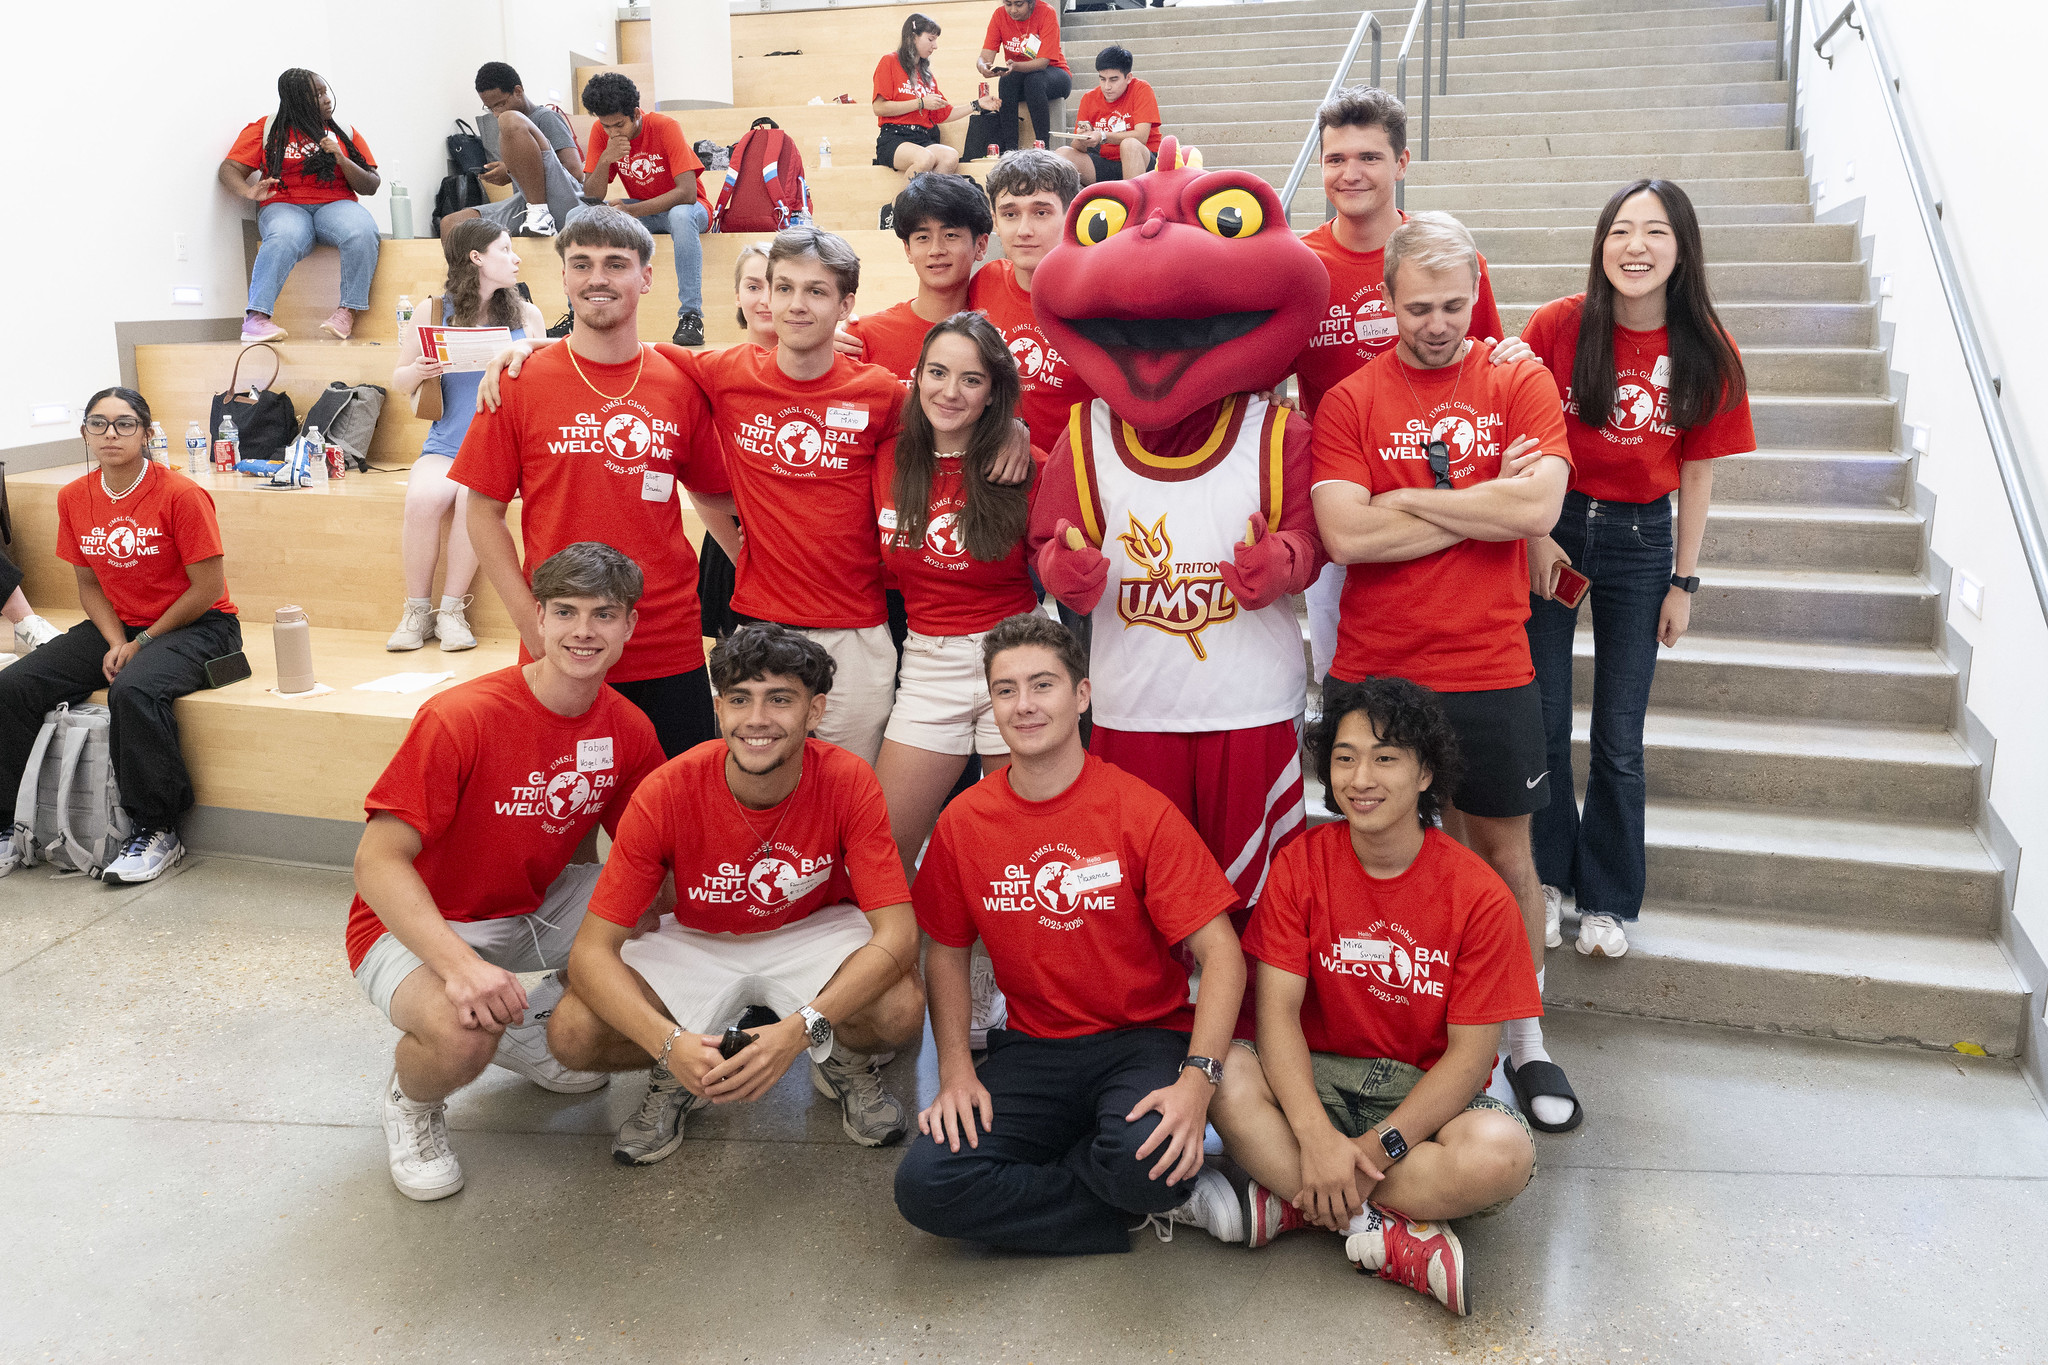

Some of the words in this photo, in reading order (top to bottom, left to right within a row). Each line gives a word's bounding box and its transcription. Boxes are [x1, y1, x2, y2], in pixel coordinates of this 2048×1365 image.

[648, 153, 663, 161] BAL
[652, 166, 665, 174] ME
[1351, 284, 1374, 303] UMSL
[1329, 304, 1351, 319] GL
[1012, 323, 1033, 334] UMSL
[1319, 318, 1352, 333] TRIT
[1309, 332, 1355, 348] WELC
[1042, 359, 1056, 373] N
[1039, 372, 1064, 388] ME
[601, 398, 626, 414] UMSL
[628, 399, 654, 418] Global
[1429, 403, 1451, 419] UMSL
[1453, 401, 1478, 416] Global
[1653, 406, 1667, 419] N
[575, 412, 601, 426] GL
[651, 417, 681, 437] BAL
[778, 406, 802, 419] UMSL
[803, 407, 827, 429] Global
[1406, 418, 1431, 432] GL
[1476, 416, 1503, 429] BAL
[558, 425, 602, 439] TRIT
[651, 432, 665, 446] N
[754, 413, 776, 429] GL
[825, 429, 859, 445] BAL
[1599, 426, 1643, 445] 2025-2026
[1649, 420, 1676, 437] ME
[739, 422, 774, 441] TRIT
[823, 442, 837, 455] N
[1390, 432, 1432, 446] TRIT
[1476, 428, 1491, 441] N
[547, 439, 605, 455] WELC
[651, 446, 674, 461] ME
[733, 432, 774, 457] WELC
[820, 455, 849, 470] ME
[1476, 442, 1500, 457] ME
[603, 459, 648, 475] 2025-2026
[930, 496, 952, 513] UMSL
[108, 516, 125, 528] UMSL
[91, 527, 107, 536] GL
[137, 527, 162, 537] BAL
[81, 535, 106, 546] TRIT
[137, 537, 146, 546] N
[80, 545, 106, 555] WELC
[137, 545, 160, 556] ME
[923, 555, 969, 571] 2025-2026
[1175, 561, 1221, 575] TRITON
[1119, 581, 1238, 630] UMSL
[583, 741, 609, 752] Fabian
[550, 754, 574, 770] UMSL
[528, 771, 547, 786] GL
[511, 787, 545, 800] TRIT
[588, 789, 603, 801] N
[494, 801, 545, 816] WELC
[582, 801, 605, 815] ME
[775, 841, 803, 859] Global
[1029, 843, 1055, 863] UMSL
[717, 862, 746, 877] GL
[801, 854, 835, 873] BAL
[1005, 864, 1030, 879] GL
[702, 873, 746, 889] TRIT
[990, 881, 1030, 895] TRIT
[688, 886, 748, 904] WELC
[983, 896, 1037, 912] WELC
[1084, 895, 1116, 911] ME
[1038, 915, 1084, 931] 2025-2026
[1390, 922, 1417, 946] Global
[1343, 940, 1363, 950] Mira
[1414, 946, 1450, 967] BAL
[1319, 951, 1368, 977] WELC
[1412, 980, 1445, 998] ME
[1413, 962, 1430, 978] N
